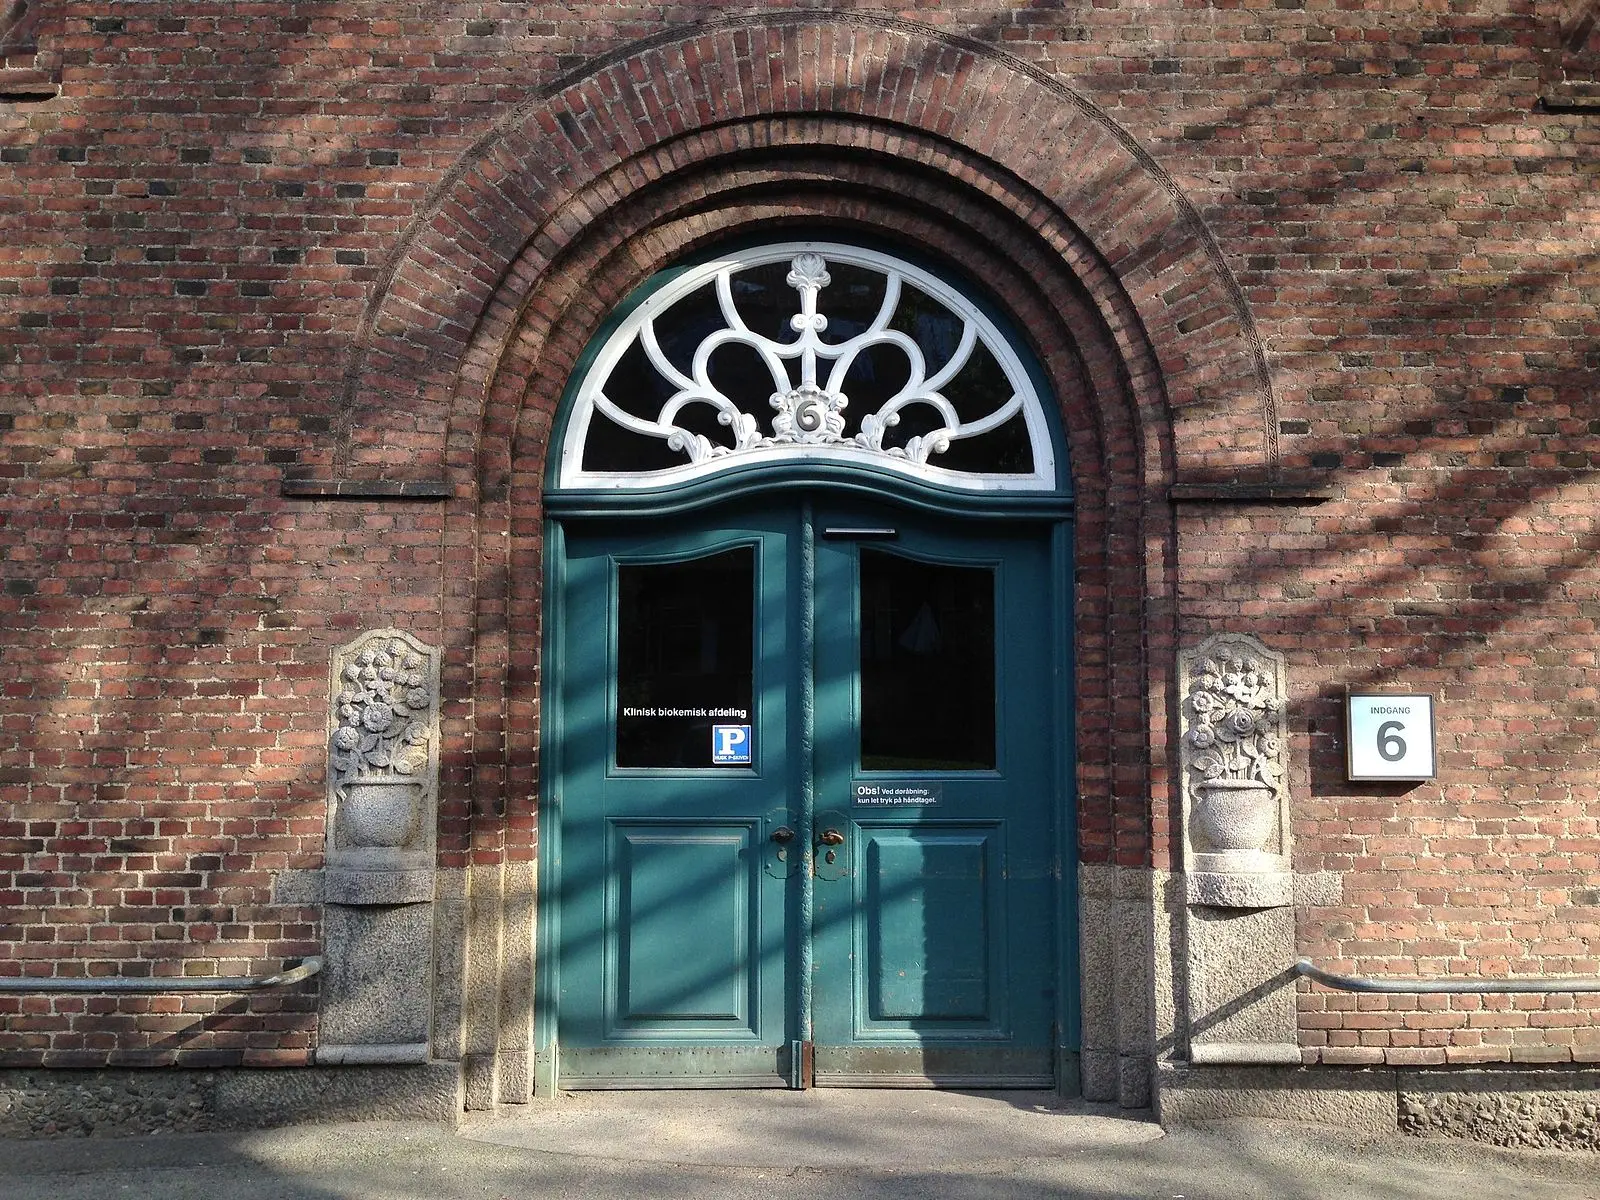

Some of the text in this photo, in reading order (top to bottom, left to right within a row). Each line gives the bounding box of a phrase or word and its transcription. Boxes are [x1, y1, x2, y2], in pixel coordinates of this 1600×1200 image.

[796, 400, 821, 432] 6
[623, 707, 747, 719] Klinisk biokemisk afdeling
[1370, 706, 1411, 715] INDGANG
[718, 728, 746, 755] P
[1376, 720, 1407, 762] 6
[857, 786, 880, 795] Obs!
[880, 797, 893, 805] tryk
[893, 796, 902, 805] på
[902, 796, 937, 805] håndtaget.
